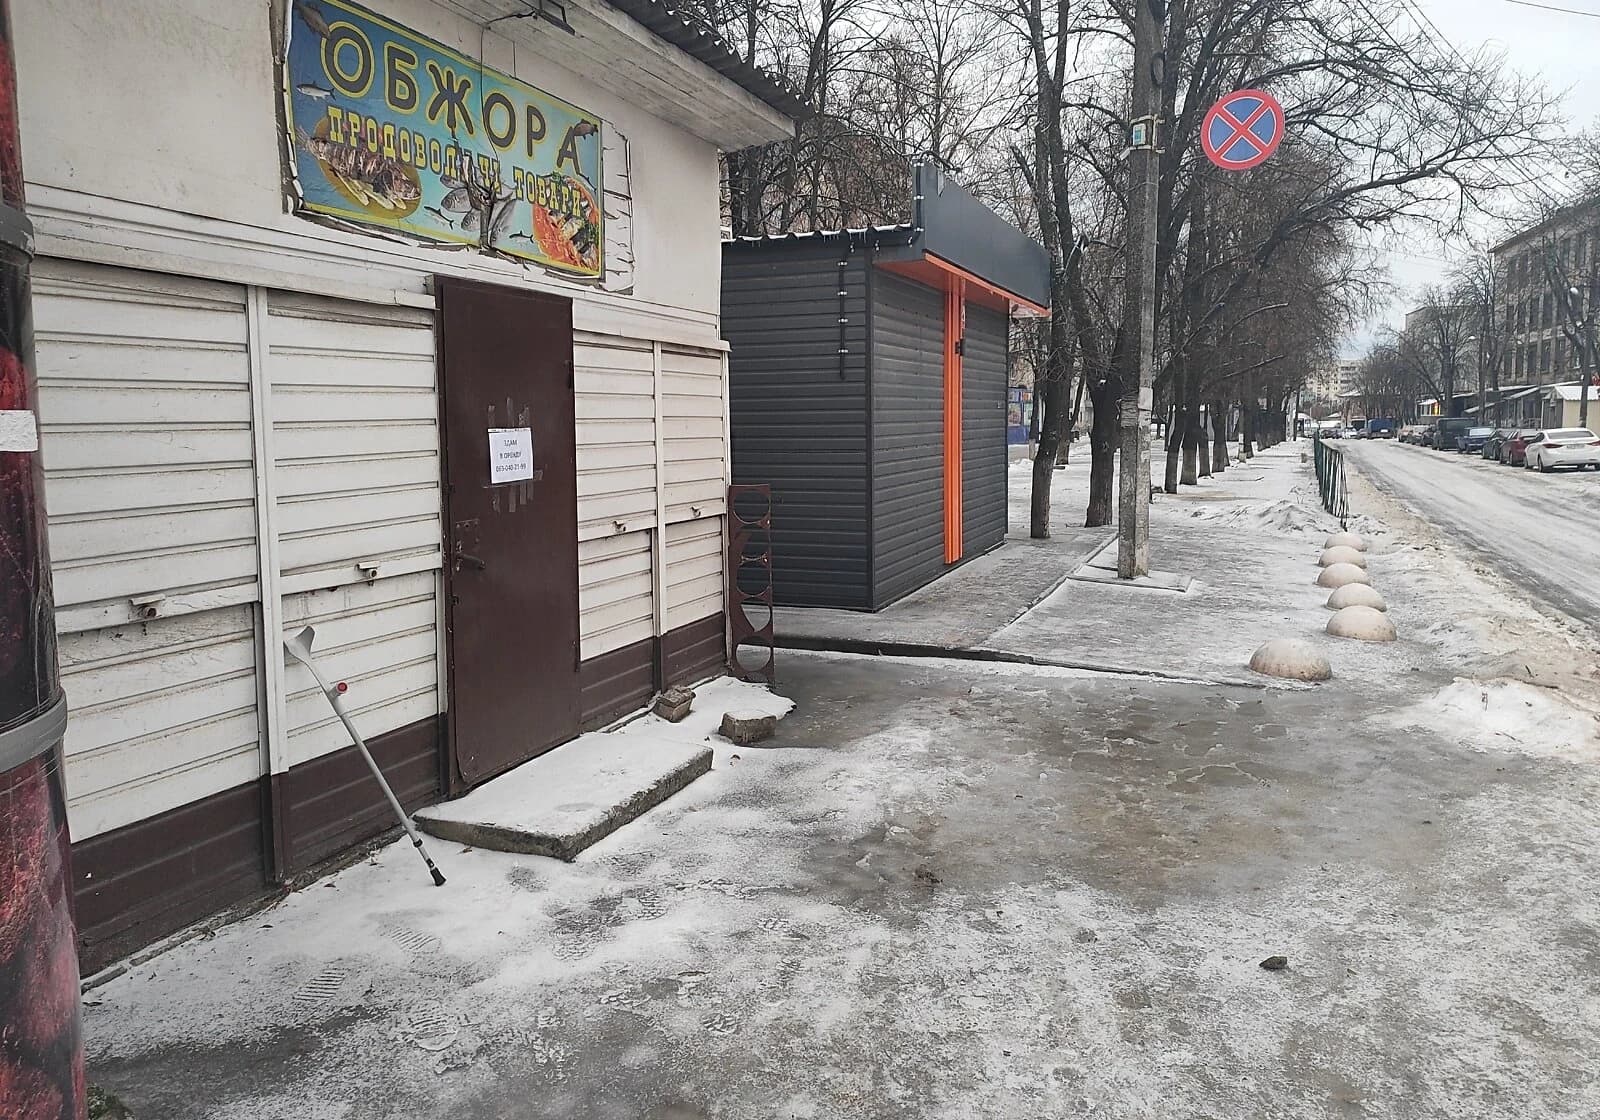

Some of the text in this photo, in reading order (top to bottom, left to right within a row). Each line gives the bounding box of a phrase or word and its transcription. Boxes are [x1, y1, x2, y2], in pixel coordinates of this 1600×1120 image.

[320, 21, 583, 177] ОБЖОРА
[326, 104, 584, 218] ПРОДОВОЛЧІ ТОВАРИ
